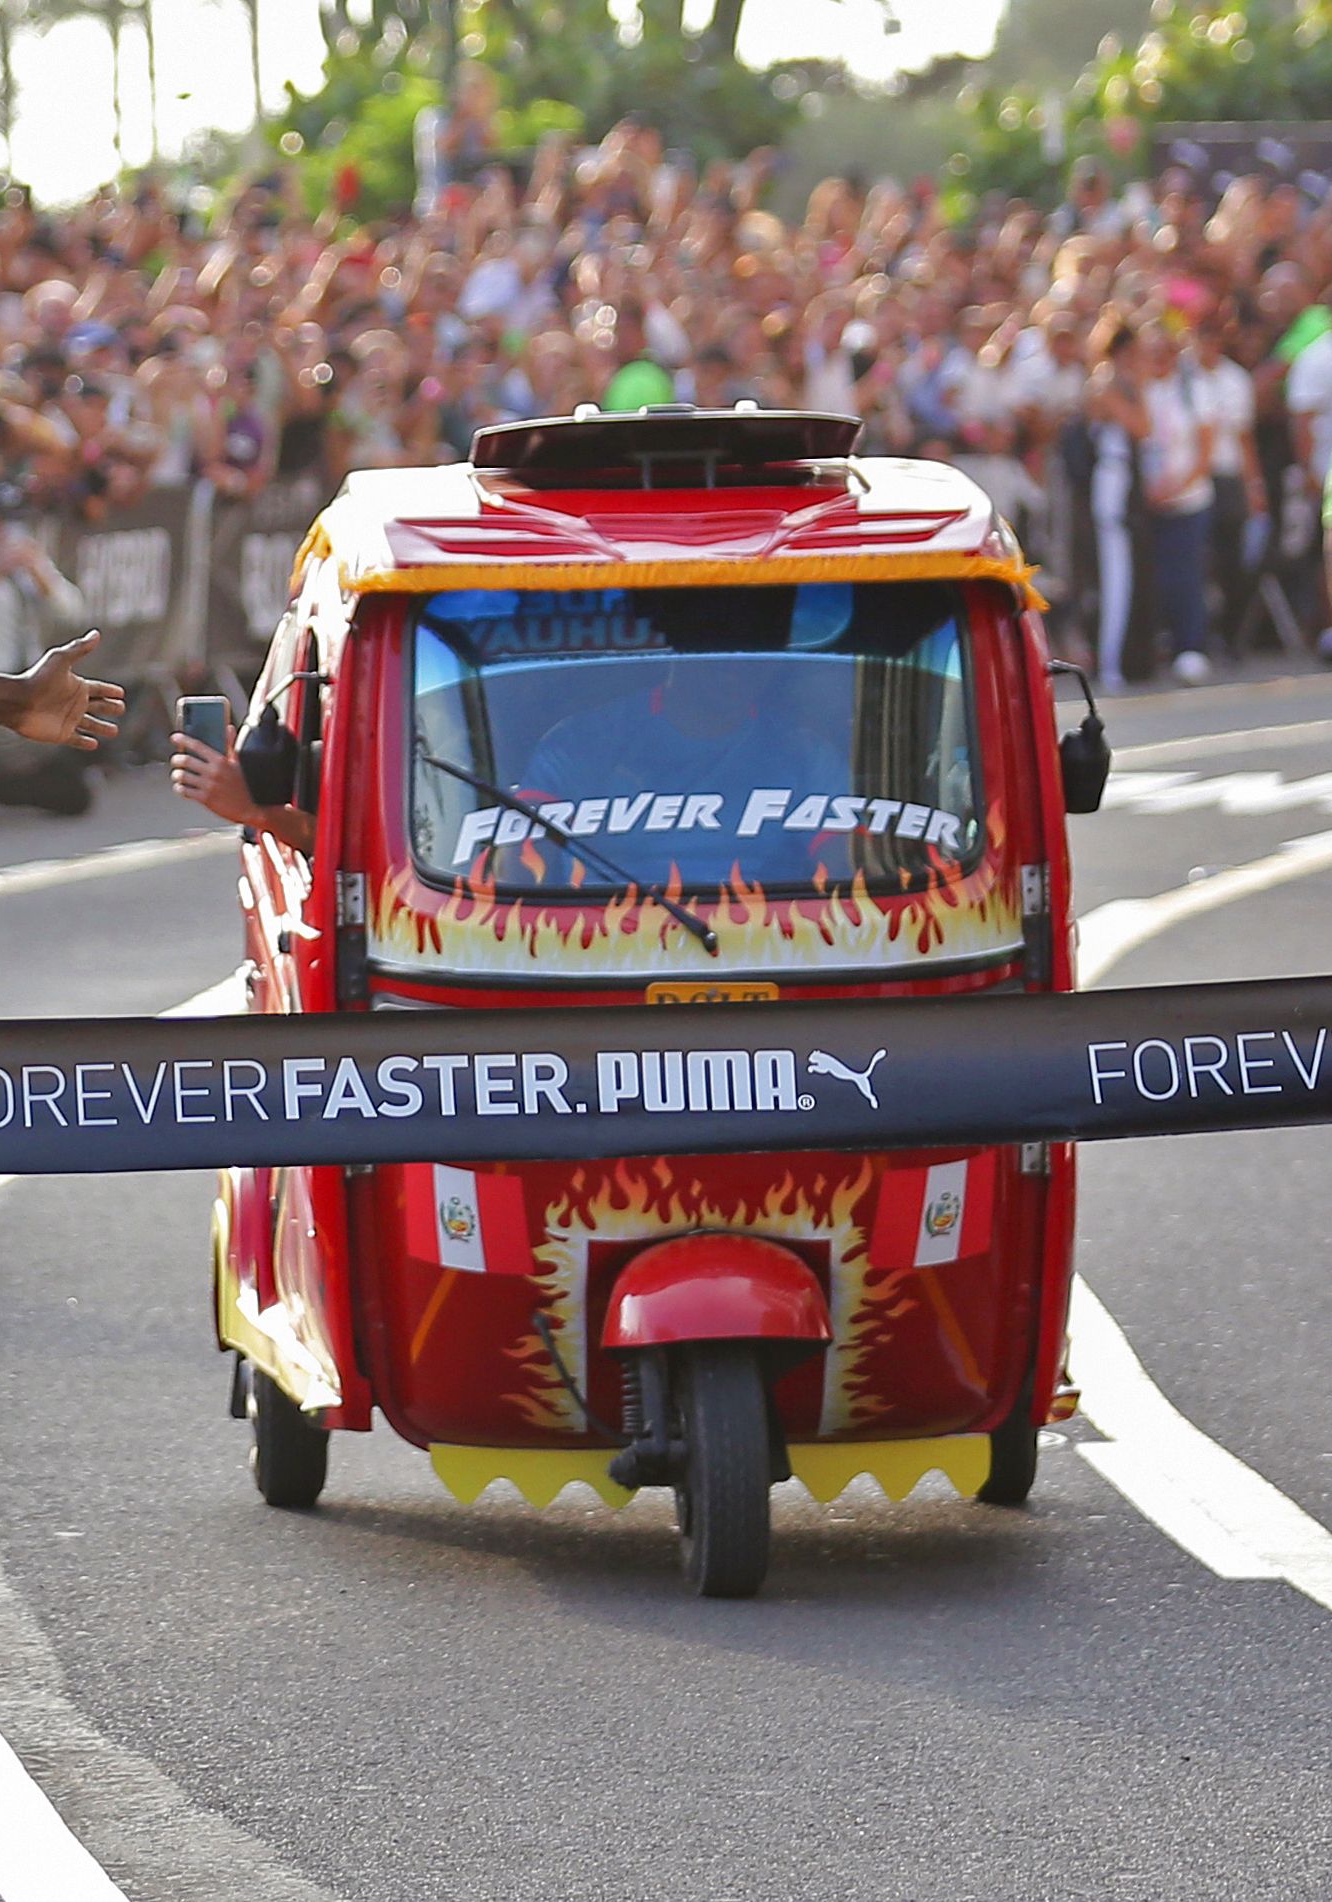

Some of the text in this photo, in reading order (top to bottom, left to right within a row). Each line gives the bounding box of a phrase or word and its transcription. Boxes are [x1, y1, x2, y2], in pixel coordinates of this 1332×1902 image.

[451, 788, 960, 867] FOREVER FASTER
[282, 1053, 587, 1120] FASTER.
